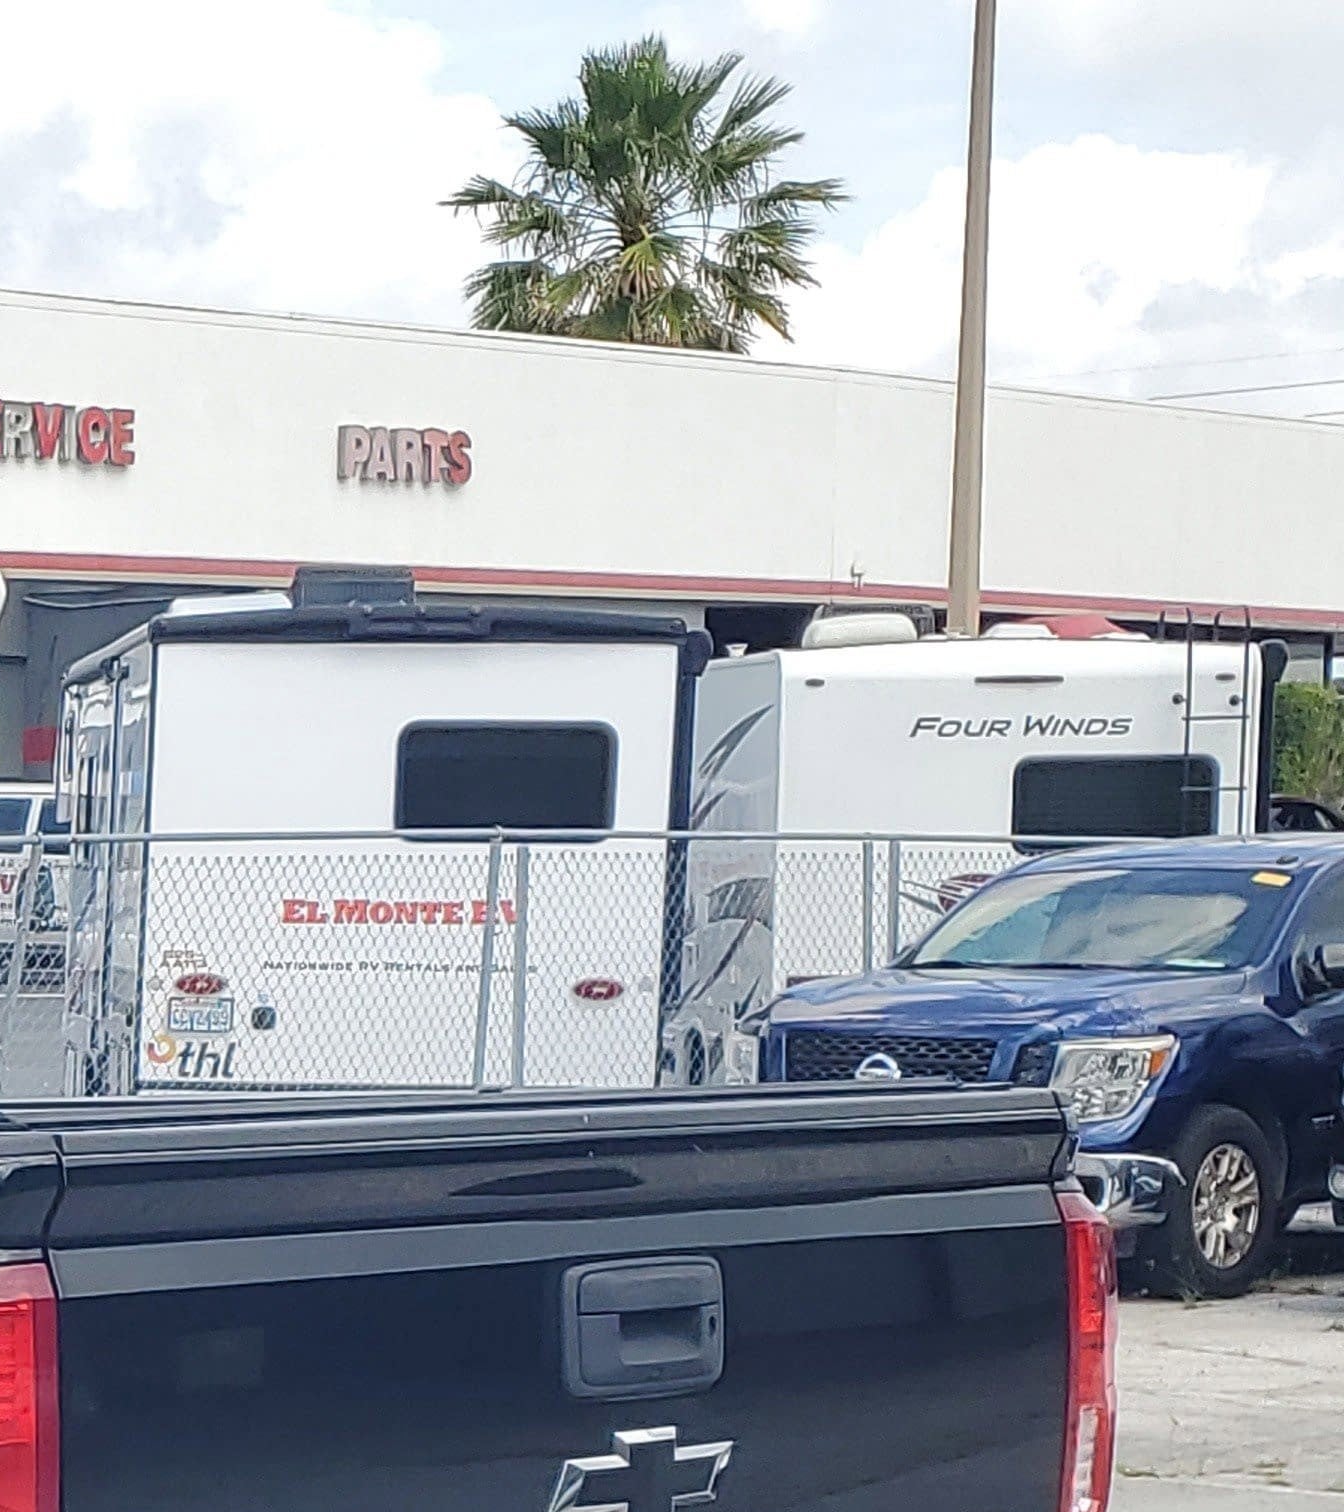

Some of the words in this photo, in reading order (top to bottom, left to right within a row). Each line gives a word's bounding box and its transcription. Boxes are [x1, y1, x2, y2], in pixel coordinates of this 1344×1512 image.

[337, 425, 472, 485] PARTS
[910, 716, 1012, 738] FOUR
[1023, 714, 1133, 737] WINDS
[282, 899, 327, 924] EL
[333, 899, 463, 924] MONTE
[178, 1041, 236, 1078] thl
